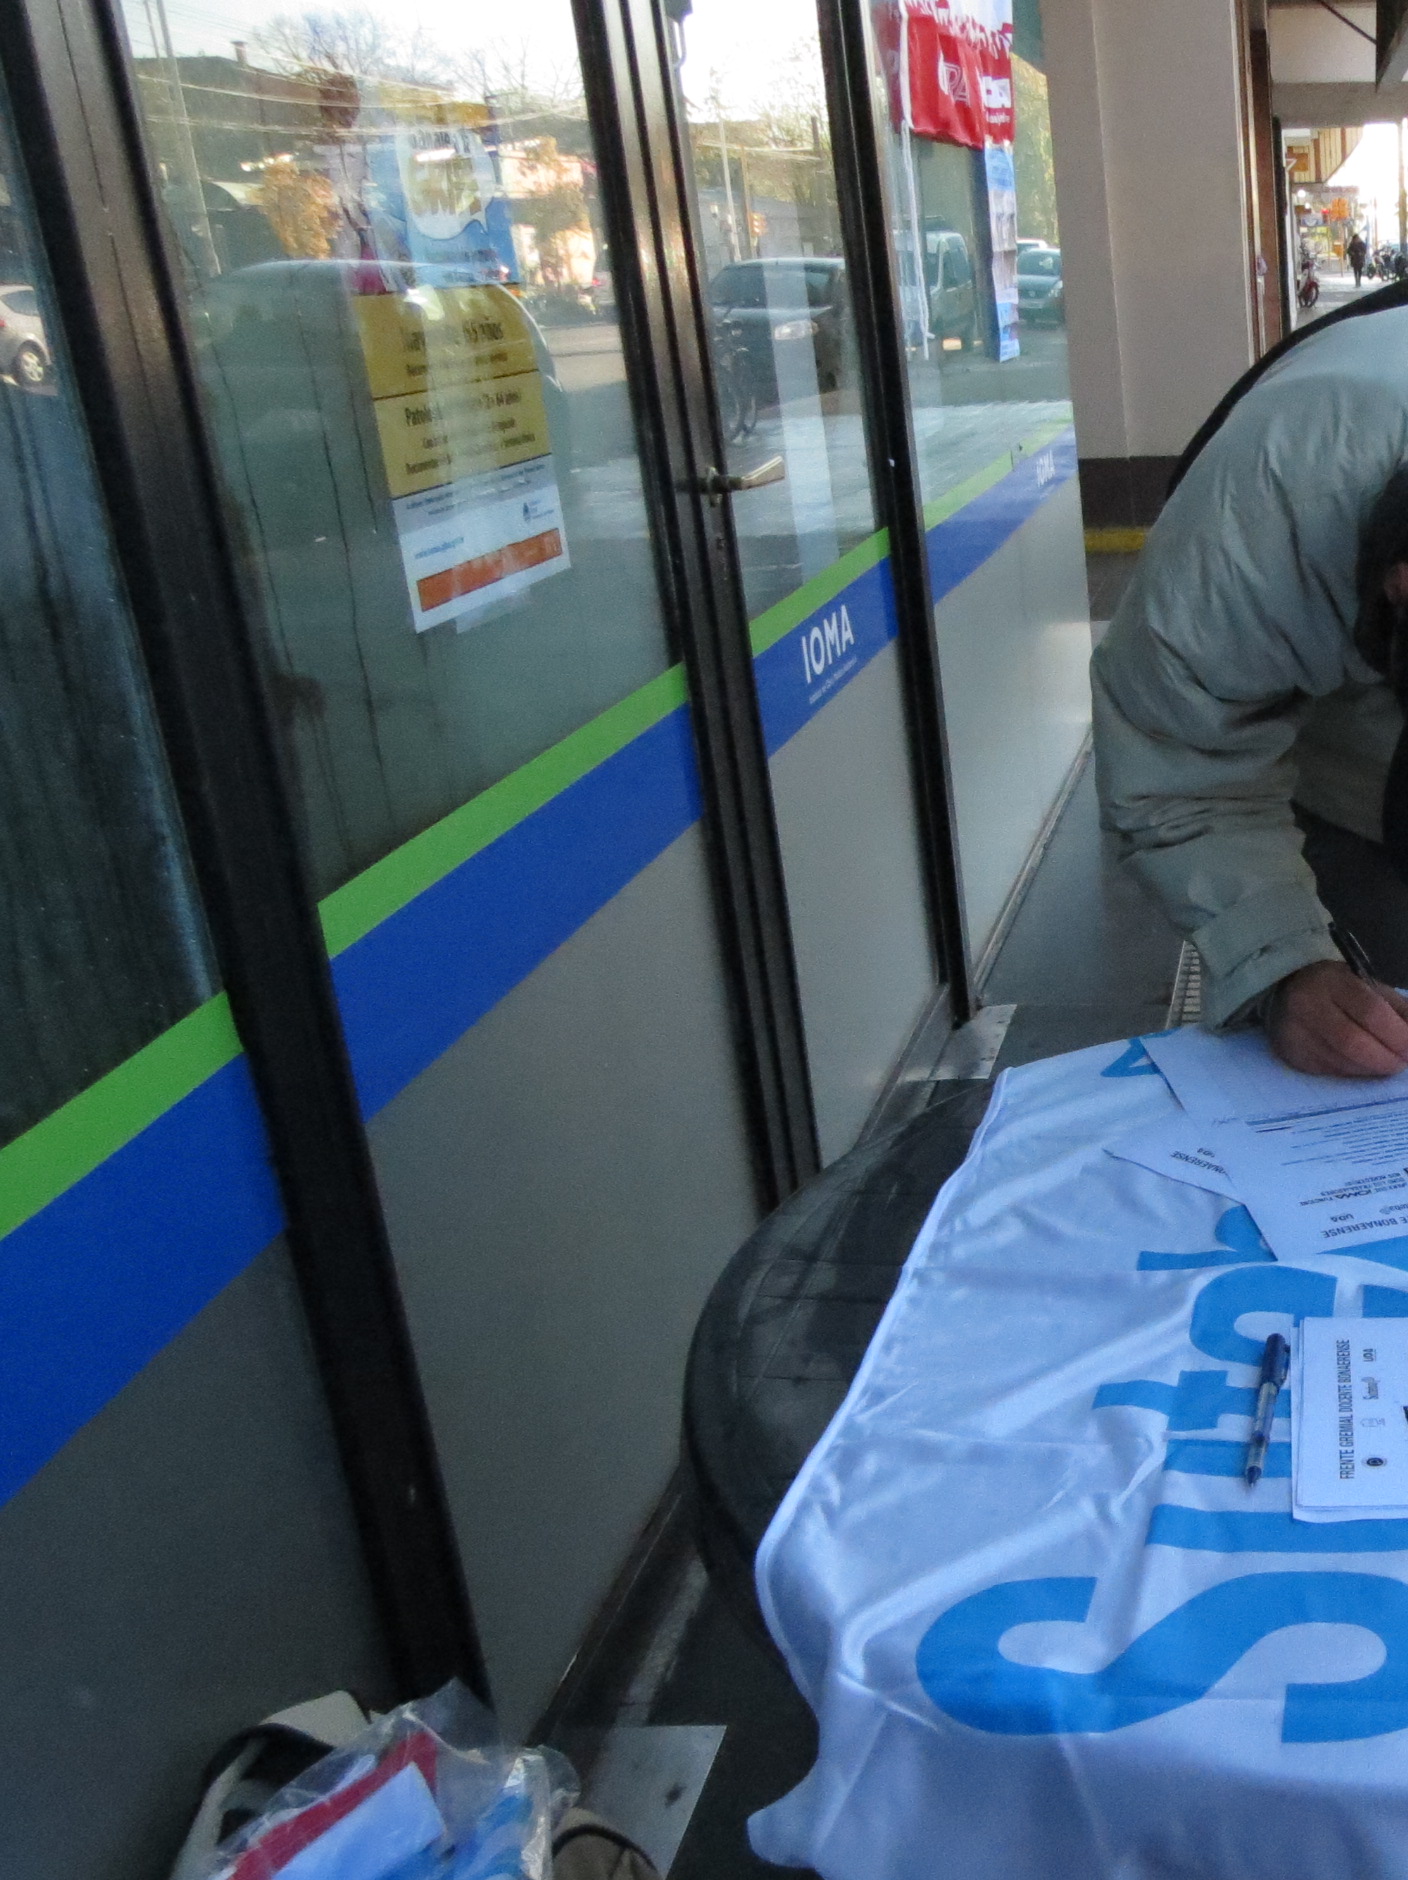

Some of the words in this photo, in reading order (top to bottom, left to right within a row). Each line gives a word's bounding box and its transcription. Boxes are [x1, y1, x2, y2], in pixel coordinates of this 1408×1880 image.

[802, 604, 855, 684] IOMA
[1335, 1189, 1372, 1199] IOMA
[1322, 1217, 1398, 1239] BONAERENSE
[1336, 1339, 1351, 1383] BONAERENSE
[1337, 1384, 1353, 1413] DOCENTE
[1339, 1414, 1354, 1448] GREMIAL
[1339, 1449, 1354, 1480] FRENTE
